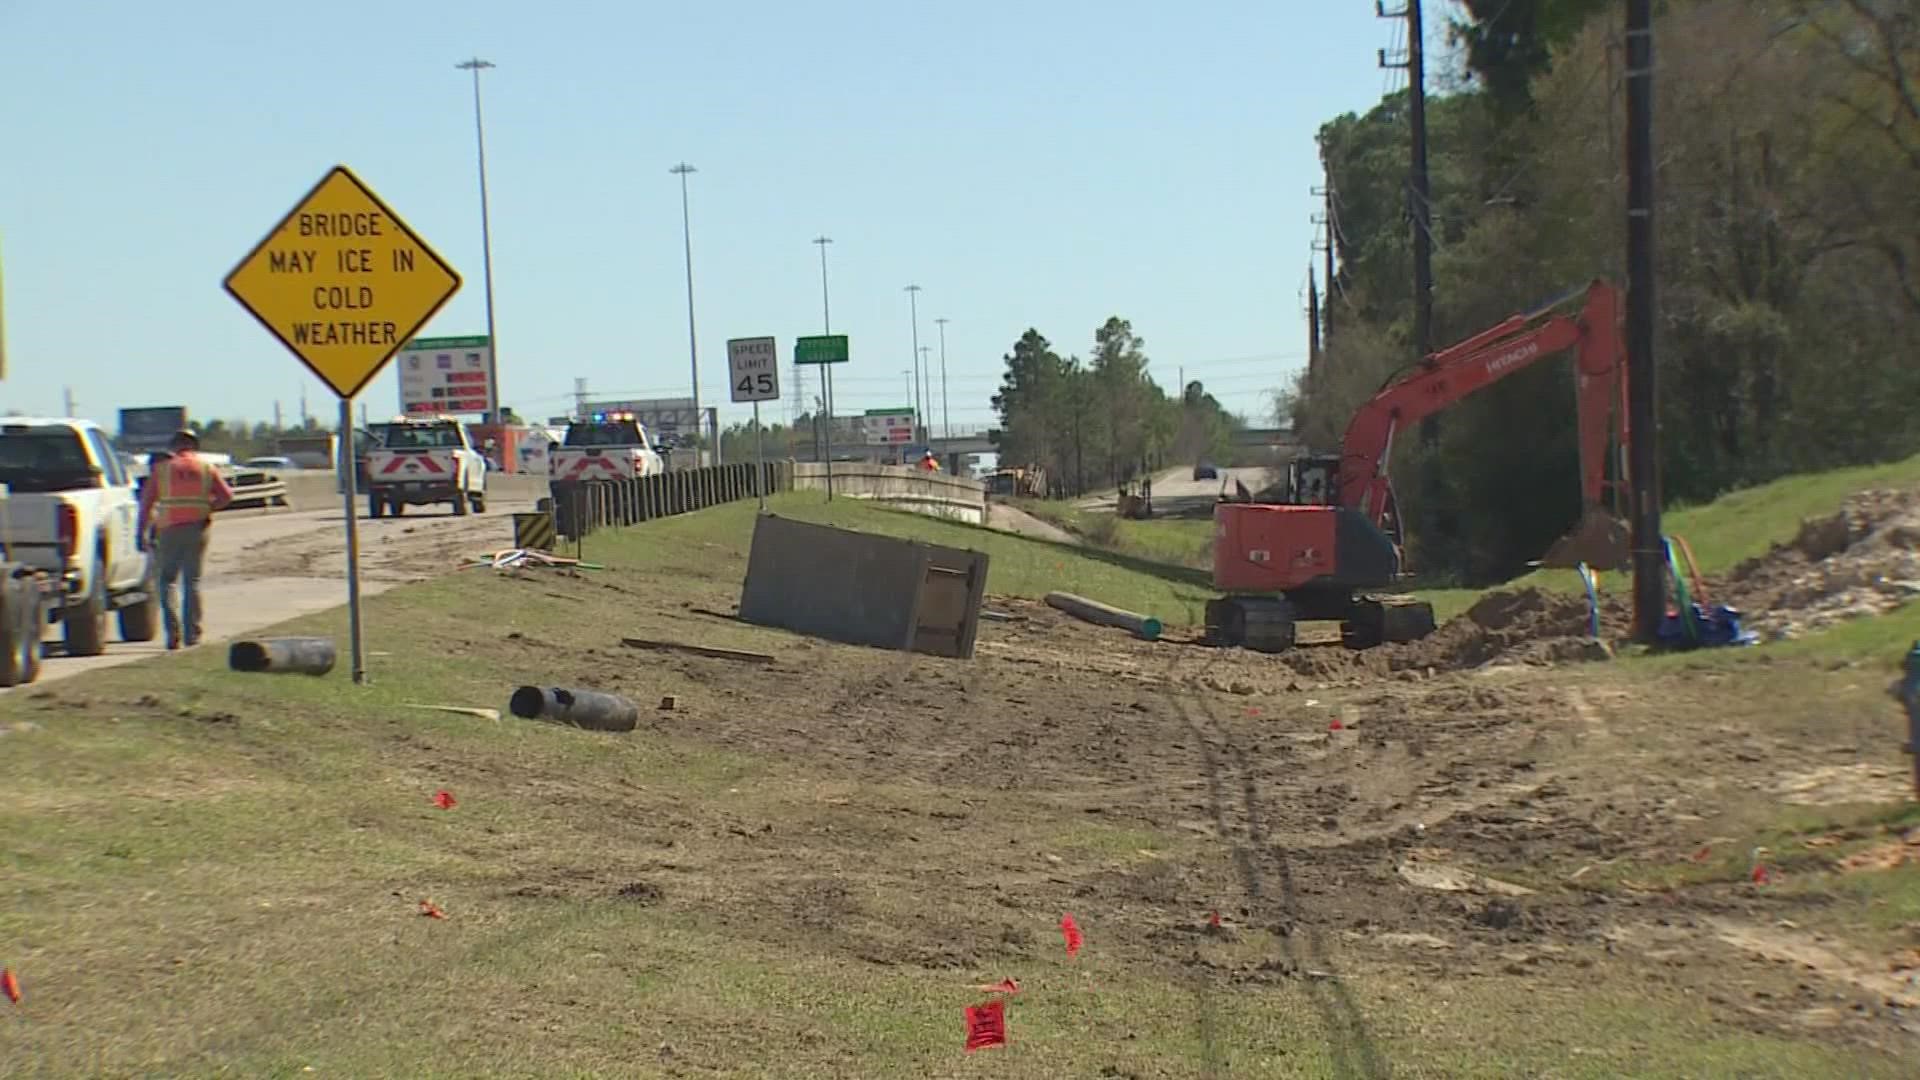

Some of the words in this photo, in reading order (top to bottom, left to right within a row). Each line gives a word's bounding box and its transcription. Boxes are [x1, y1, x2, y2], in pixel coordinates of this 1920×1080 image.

[300, 213, 383, 236] BRIDGE
[269, 250, 317, 273] MAY
[338, 250, 373, 273] ICE
[393, 250, 414, 272] IN
[313, 287, 373, 309] COLD
[293, 322, 397, 345] WEATHER
[735, 343, 772, 355] SPEED
[1486, 342, 1537, 374] HITACHI
[737, 358, 768, 370] LIMIT
[737, 374, 774, 395] 45
